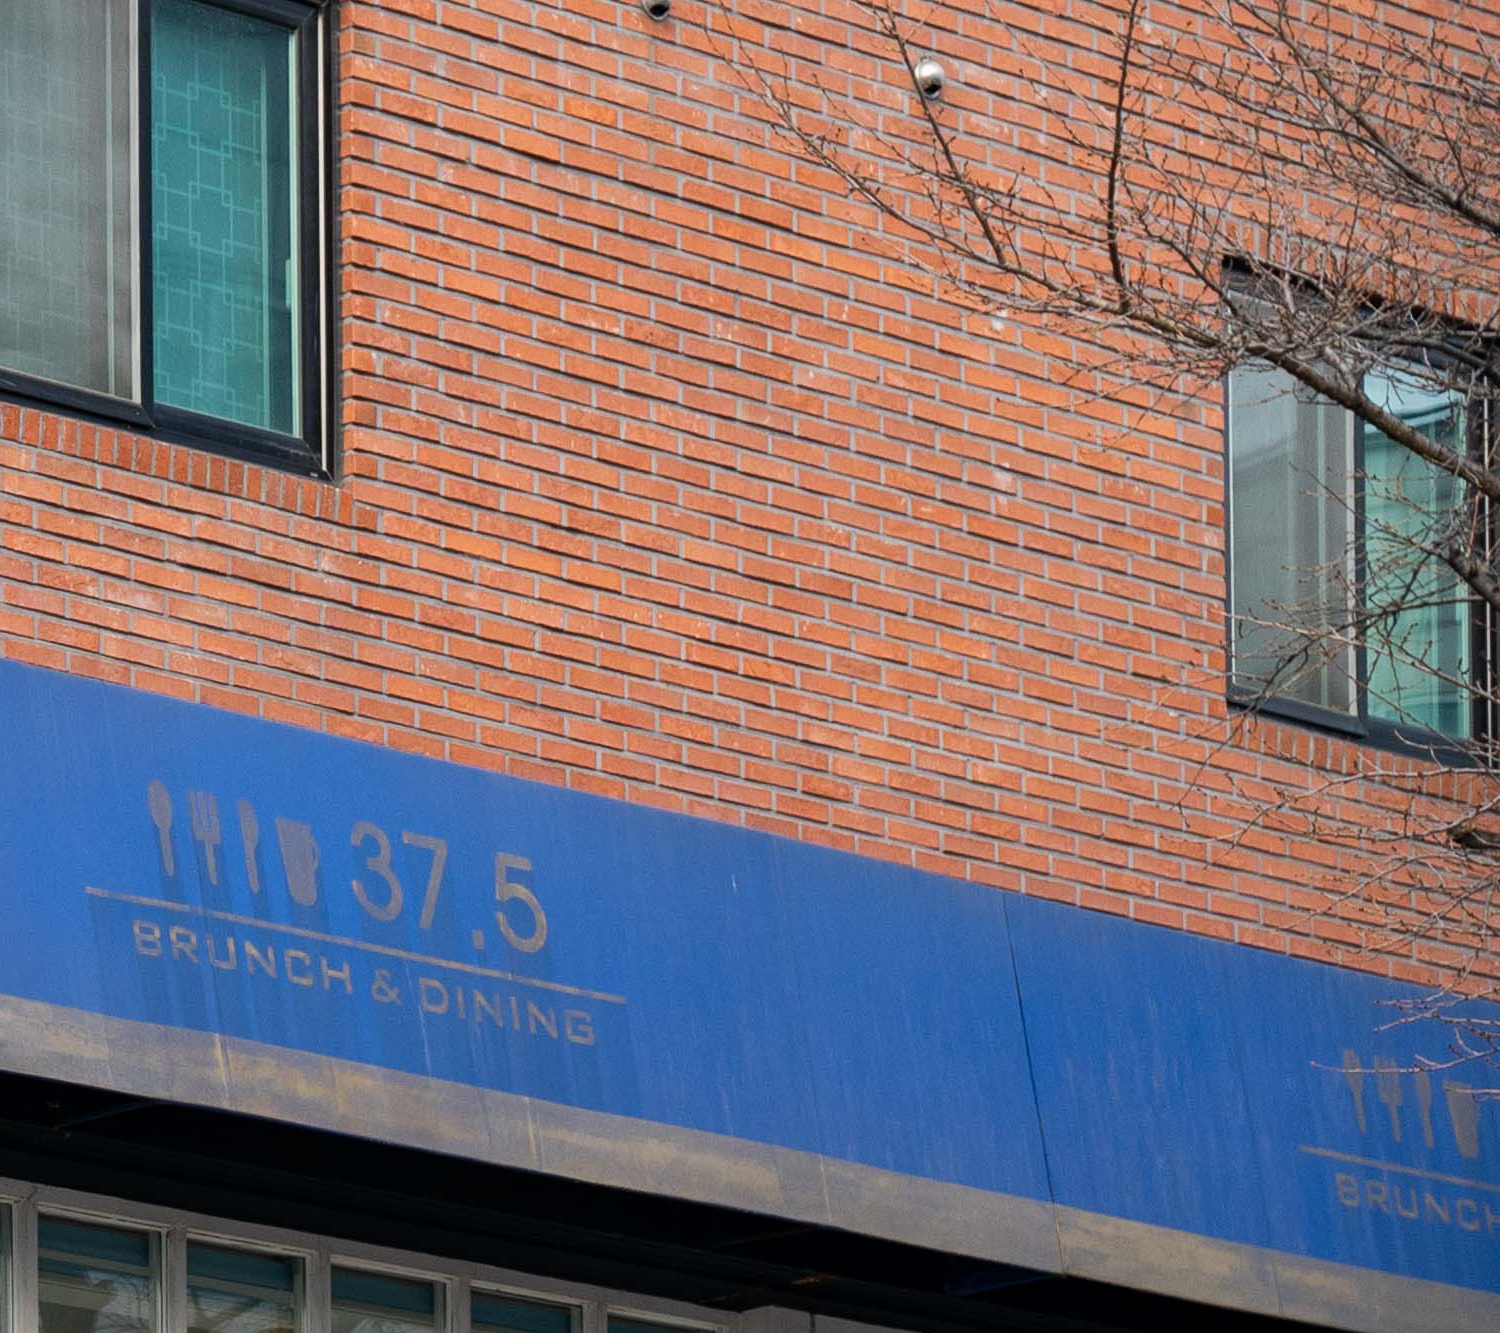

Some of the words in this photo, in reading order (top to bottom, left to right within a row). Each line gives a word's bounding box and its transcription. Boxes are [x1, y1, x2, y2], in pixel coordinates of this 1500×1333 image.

[351, 820, 548, 955] 37.5
[132, 918, 353, 998] BRUNCH
[372, 967, 404, 1006] &
[418, 974, 595, 1047] DINING
